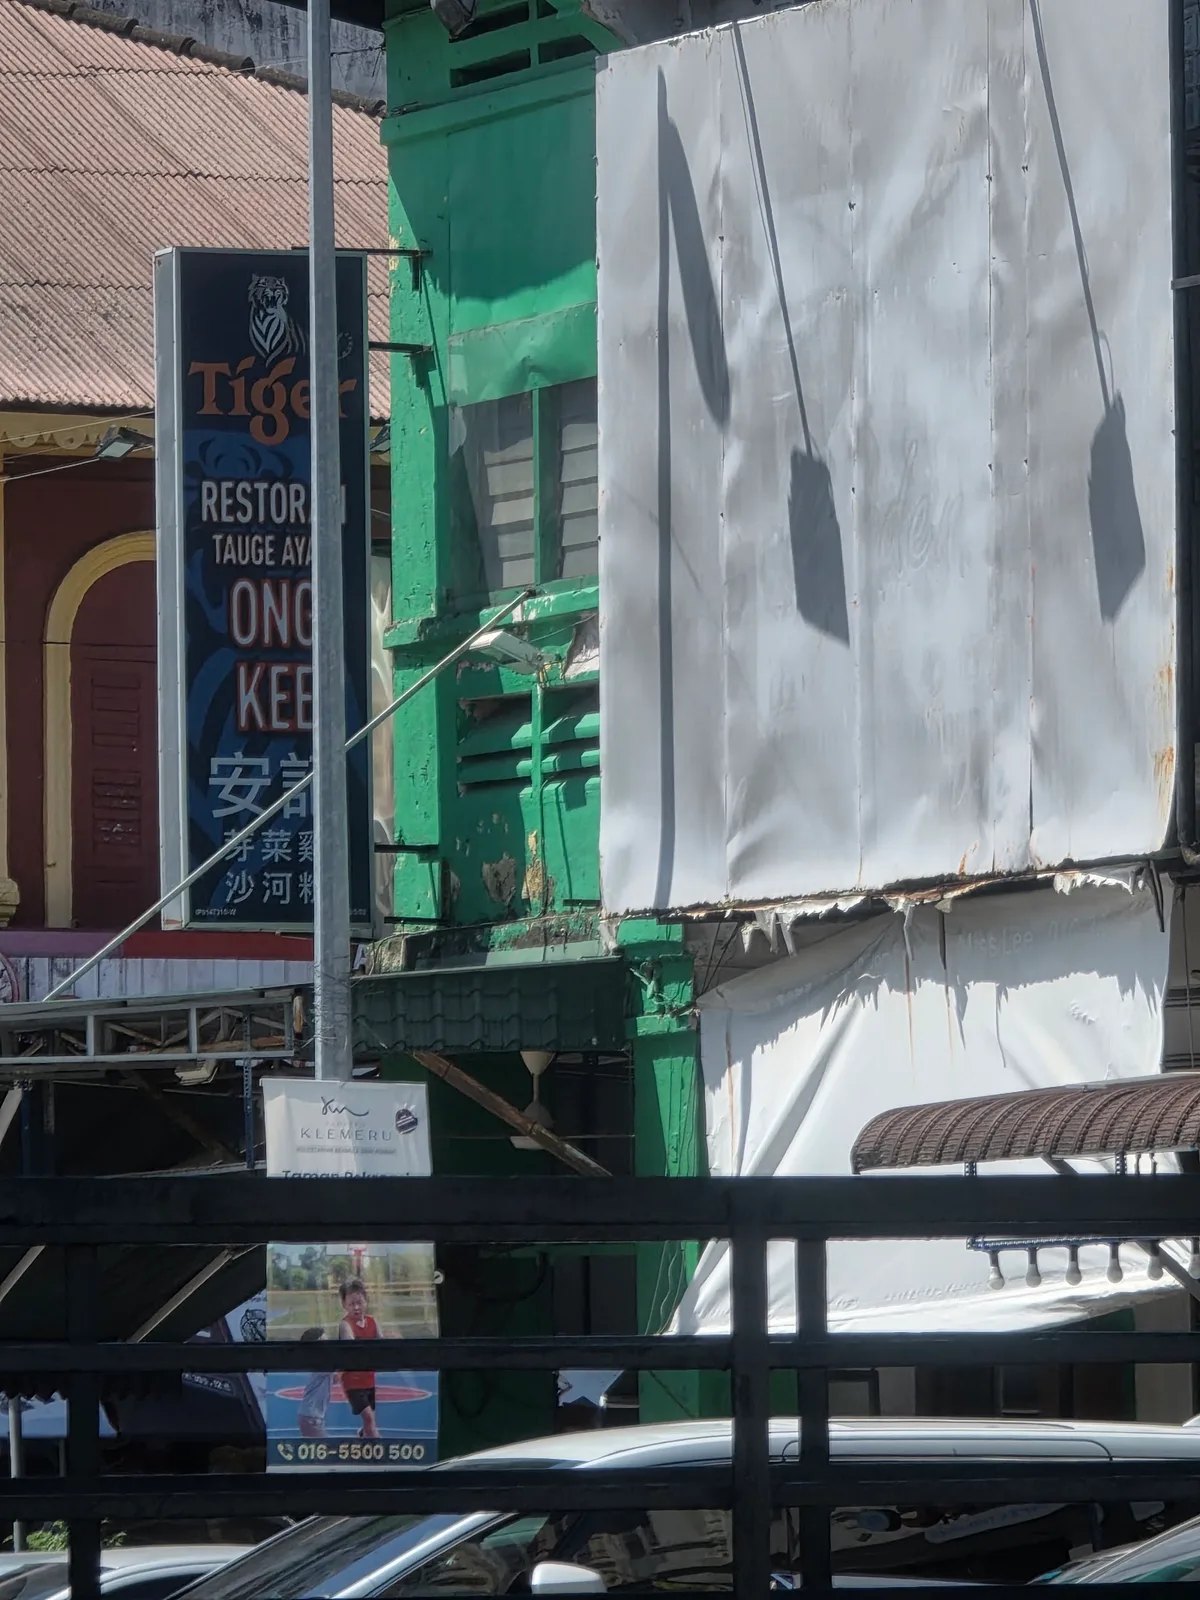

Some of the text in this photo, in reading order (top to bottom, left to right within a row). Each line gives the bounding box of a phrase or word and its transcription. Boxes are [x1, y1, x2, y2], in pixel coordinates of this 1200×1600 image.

[202, 481, 346, 525] RESTOR
[212, 535, 276, 566] TAUGE
[231, 579, 313, 646] ONG
[238, 664, 313, 731] KEE
[300, 1127, 392, 1142] KLEMERU
[297, 1444, 425, 1460] 016-5500 500
